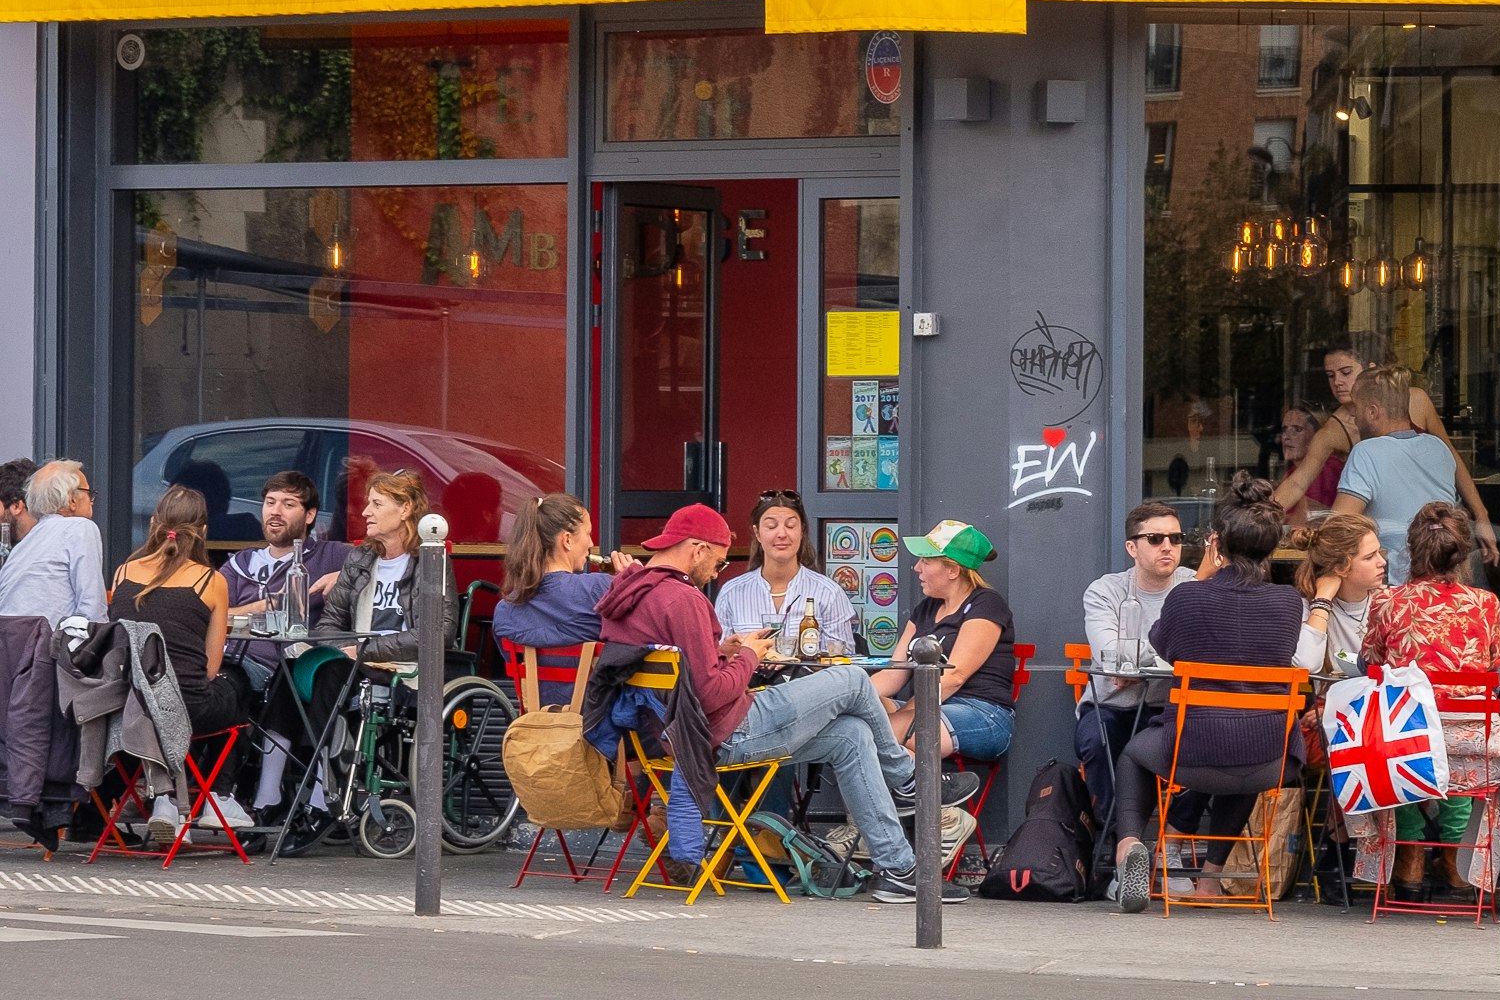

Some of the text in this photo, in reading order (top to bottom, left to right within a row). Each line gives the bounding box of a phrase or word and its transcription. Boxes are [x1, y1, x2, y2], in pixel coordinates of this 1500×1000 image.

[873, 56, 900, 64] LICENCE
[883, 67, 891, 77] R
[855, 394, 876, 402] 2017
